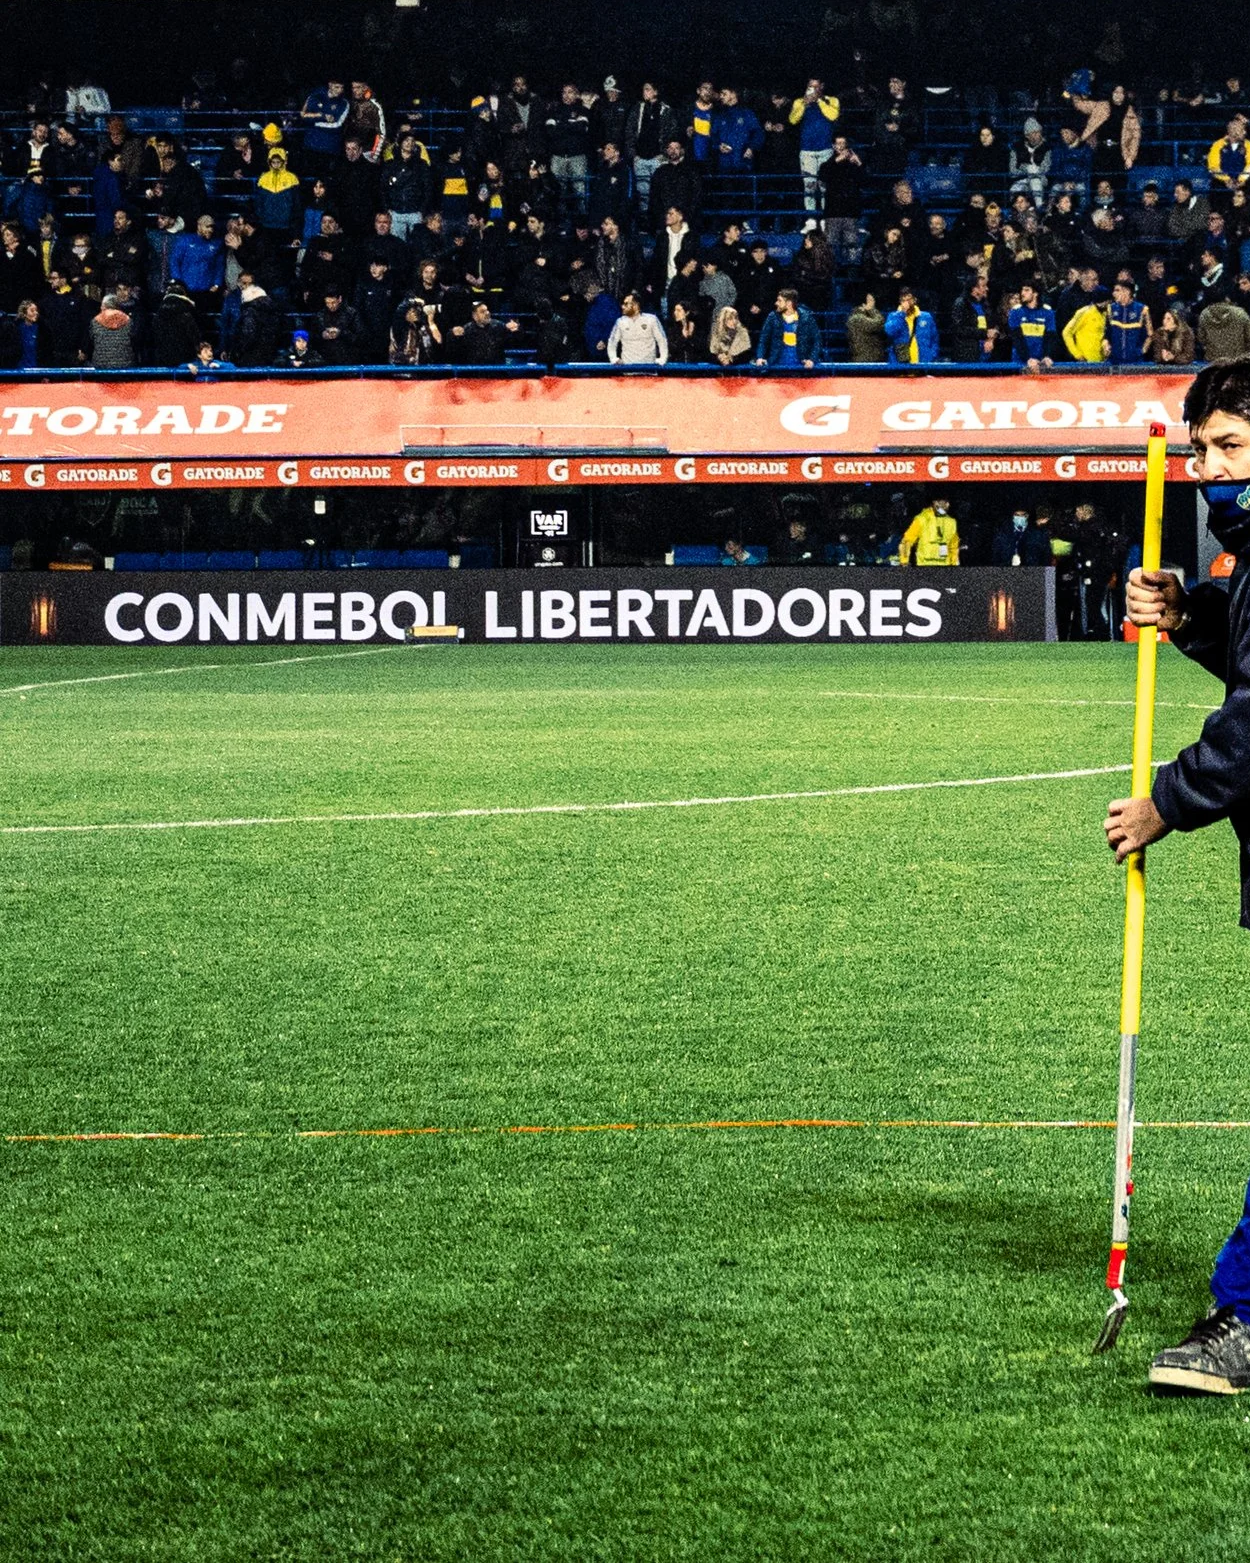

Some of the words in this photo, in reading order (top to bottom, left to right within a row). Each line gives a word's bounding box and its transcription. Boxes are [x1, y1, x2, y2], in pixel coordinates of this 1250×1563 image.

[0, 404, 288, 436] TORADE
[882, 399, 1190, 431] GATORA
[57, 469, 138, 481] GATORADE
[183, 467, 264, 479] GATORADE
[310, 466, 391, 478] GATORADE
[436, 465, 518, 478] GATORADE
[580, 464, 661, 476] GATORADE
[707, 463, 788, 475] GATORADE
[834, 462, 915, 474] GATORADE
[960, 461, 1042, 473] GATORADE
[1088, 460, 1168, 473] GATORAE
[535, 514, 563, 526] VAR
[103, 590, 465, 642] CONMEBOL
[484, 587, 943, 639] LIBERTADORES
